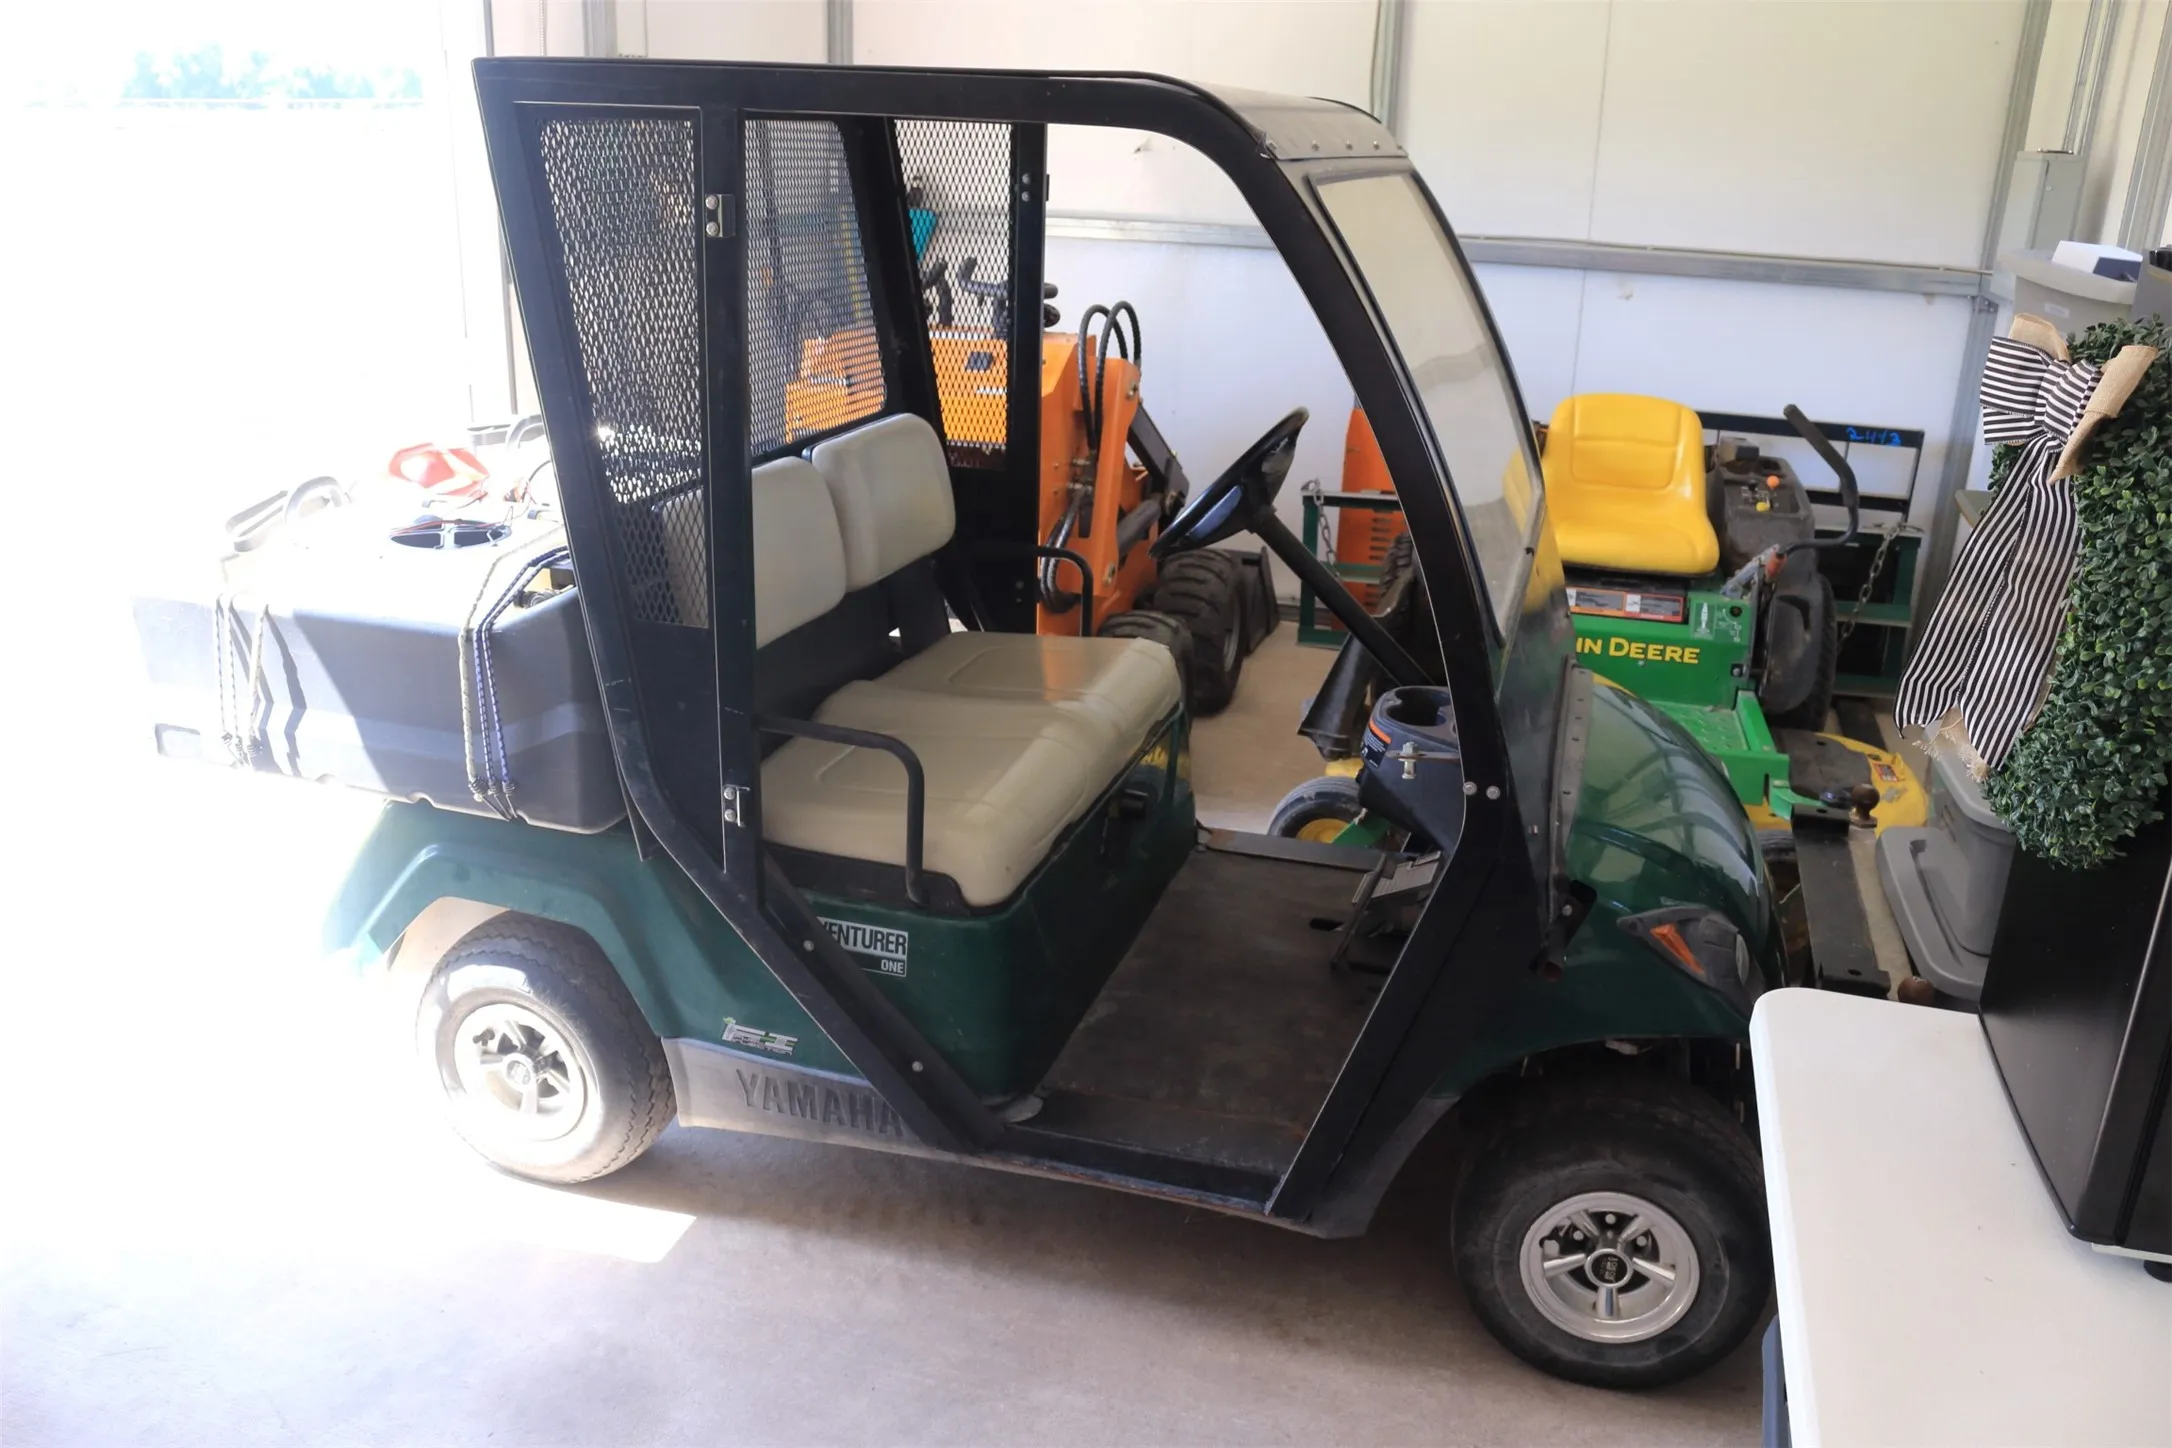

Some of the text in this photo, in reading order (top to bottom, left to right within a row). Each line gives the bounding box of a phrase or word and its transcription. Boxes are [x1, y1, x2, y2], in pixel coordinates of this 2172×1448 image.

[1608, 636, 1700, 665] DEERE
[881, 958, 905, 974] ONE
[736, 1068, 905, 1138] YAMAHA
